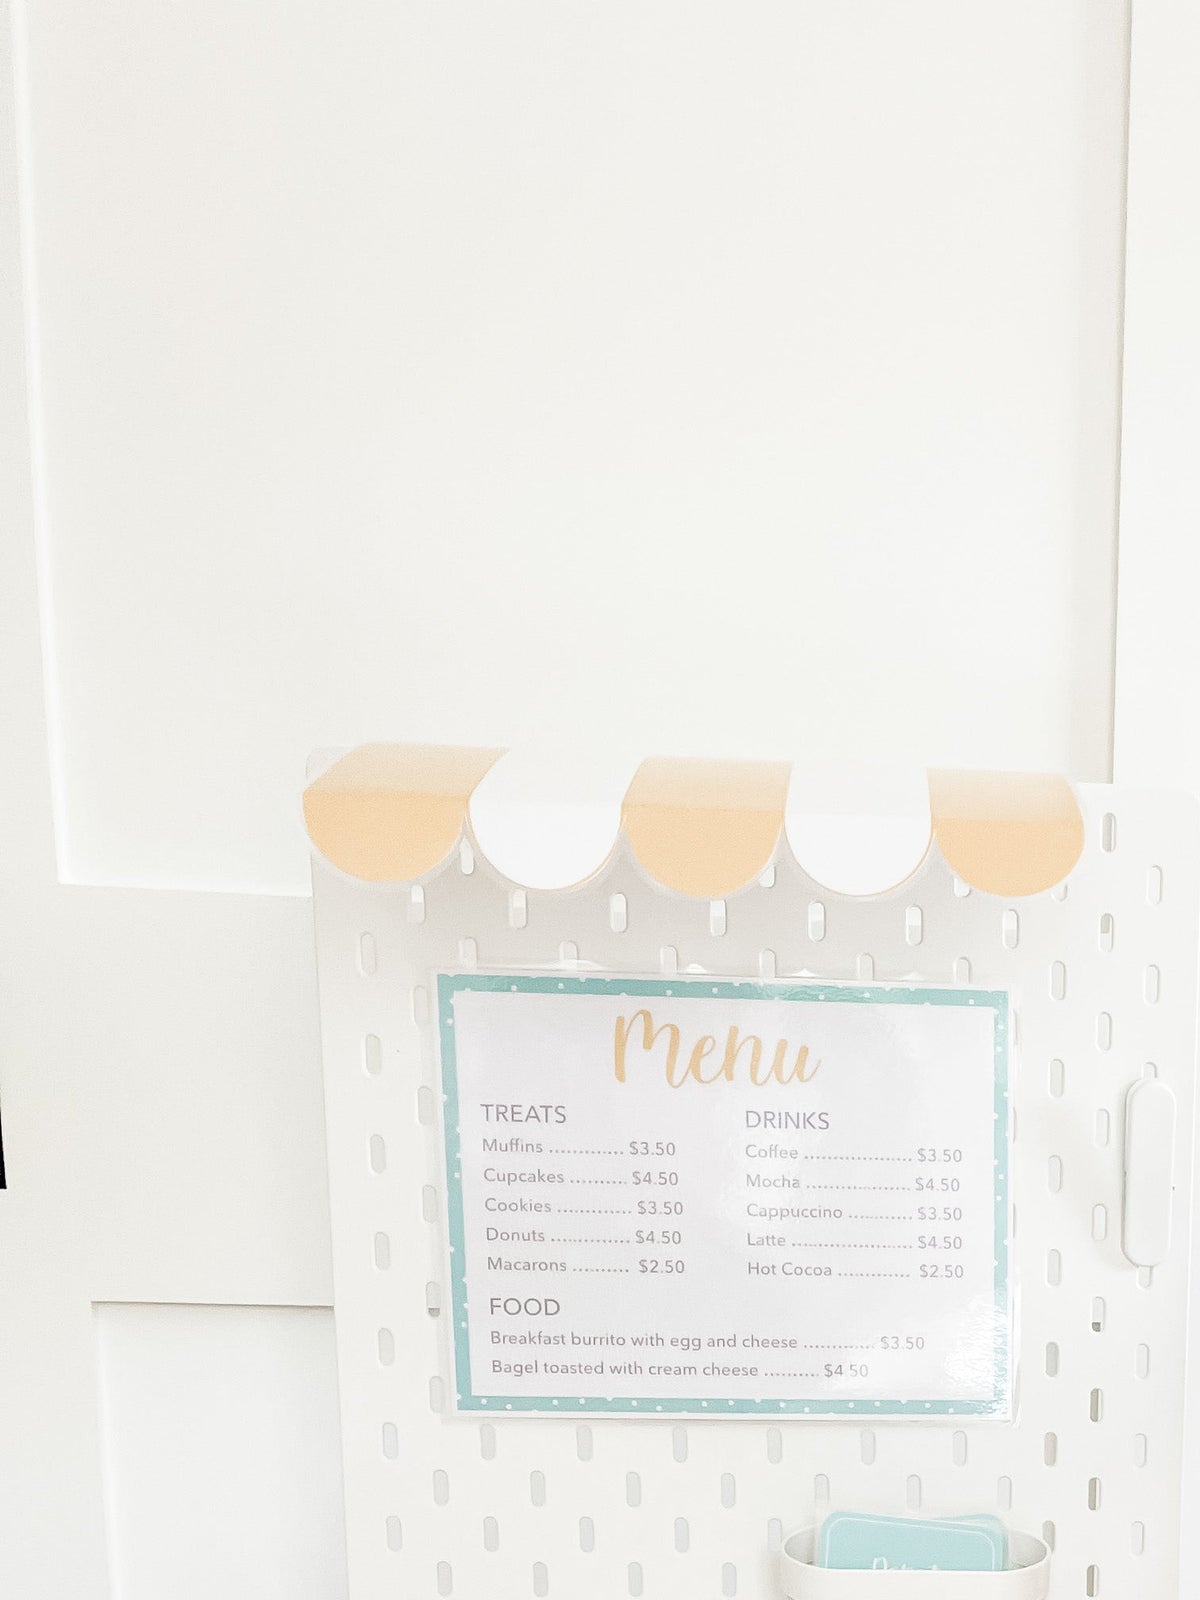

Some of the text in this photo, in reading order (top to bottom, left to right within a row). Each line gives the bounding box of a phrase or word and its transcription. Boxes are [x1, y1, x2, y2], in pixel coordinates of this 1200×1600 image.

[613, 1008, 822, 1089] Menu
[479, 1103, 567, 1124] TREATS
[745, 1110, 830, 1130] DRINKS
[482, 1137, 676, 1156] Muffins $3.50
[745, 1143, 962, 1163] Coffee $3.50
[483, 1167, 679, 1187] Cupcakes $4.50
[746, 1173, 960, 1192] Mocha $4.50
[484, 1197, 684, 1216] Cookies $3.50
[746, 1203, 963, 1222] Cappuccino $3.50
[486, 1227, 682, 1245] Donuts $4.50
[747, 1232, 963, 1250] Latte $4.50
[487, 1256, 685, 1274] Macarons $2.50
[747, 1261, 964, 1279] Hot Cocoa $2.50
[489, 1297, 561, 1316] FOOD
[490, 1330, 925, 1352] Breakfast burrito with egg and cheese $3.50
[492, 1359, 870, 1379] Bagel toasted with cream cheese $450
